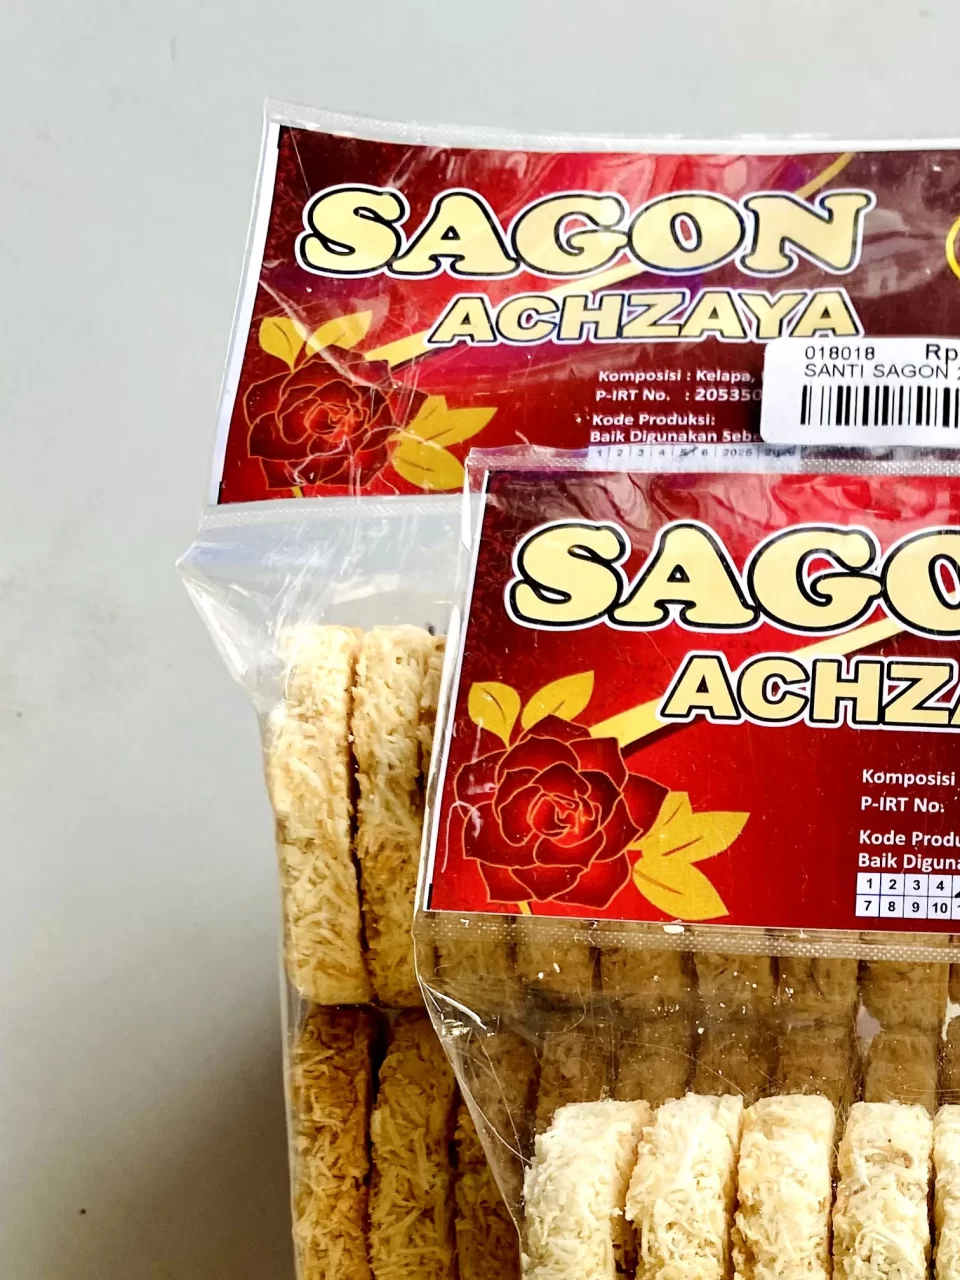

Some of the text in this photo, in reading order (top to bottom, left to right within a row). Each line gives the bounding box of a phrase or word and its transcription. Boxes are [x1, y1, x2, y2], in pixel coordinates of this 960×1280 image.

[298, 185, 874, 278] SAGON
[427, 290, 864, 342] ACHZAYA
[805, 345, 876, 361] 018018
[598, 370, 682, 383] Komposisi
[696, 370, 755, 383] Kelapa,
[804, 363, 864, 378] SANTI
[873, 364, 948, 379] SAGON
[596, 389, 638, 401] P-IRT
[643, 389, 670, 401] No.
[592, 413, 715, 427] Kode Produksi:
[590, 430, 625, 443] Baik
[630, 430, 717, 443] Digunakan
[862, 769, 956, 787] Komposisi
[861, 795, 909, 813] P-IRT
[914, 797, 945, 813] No.
[859, 829, 906, 846] Kode
[857, 852, 898, 869] Baik
[888, 878, 897, 890] 2
[912, 879, 921, 891] 3
[936, 880, 945, 892] 4
[864, 900, 872, 911] 7
[887, 901, 896, 912] 8
[911, 902, 920, 913] 9
[932, 902, 948, 913] 10
